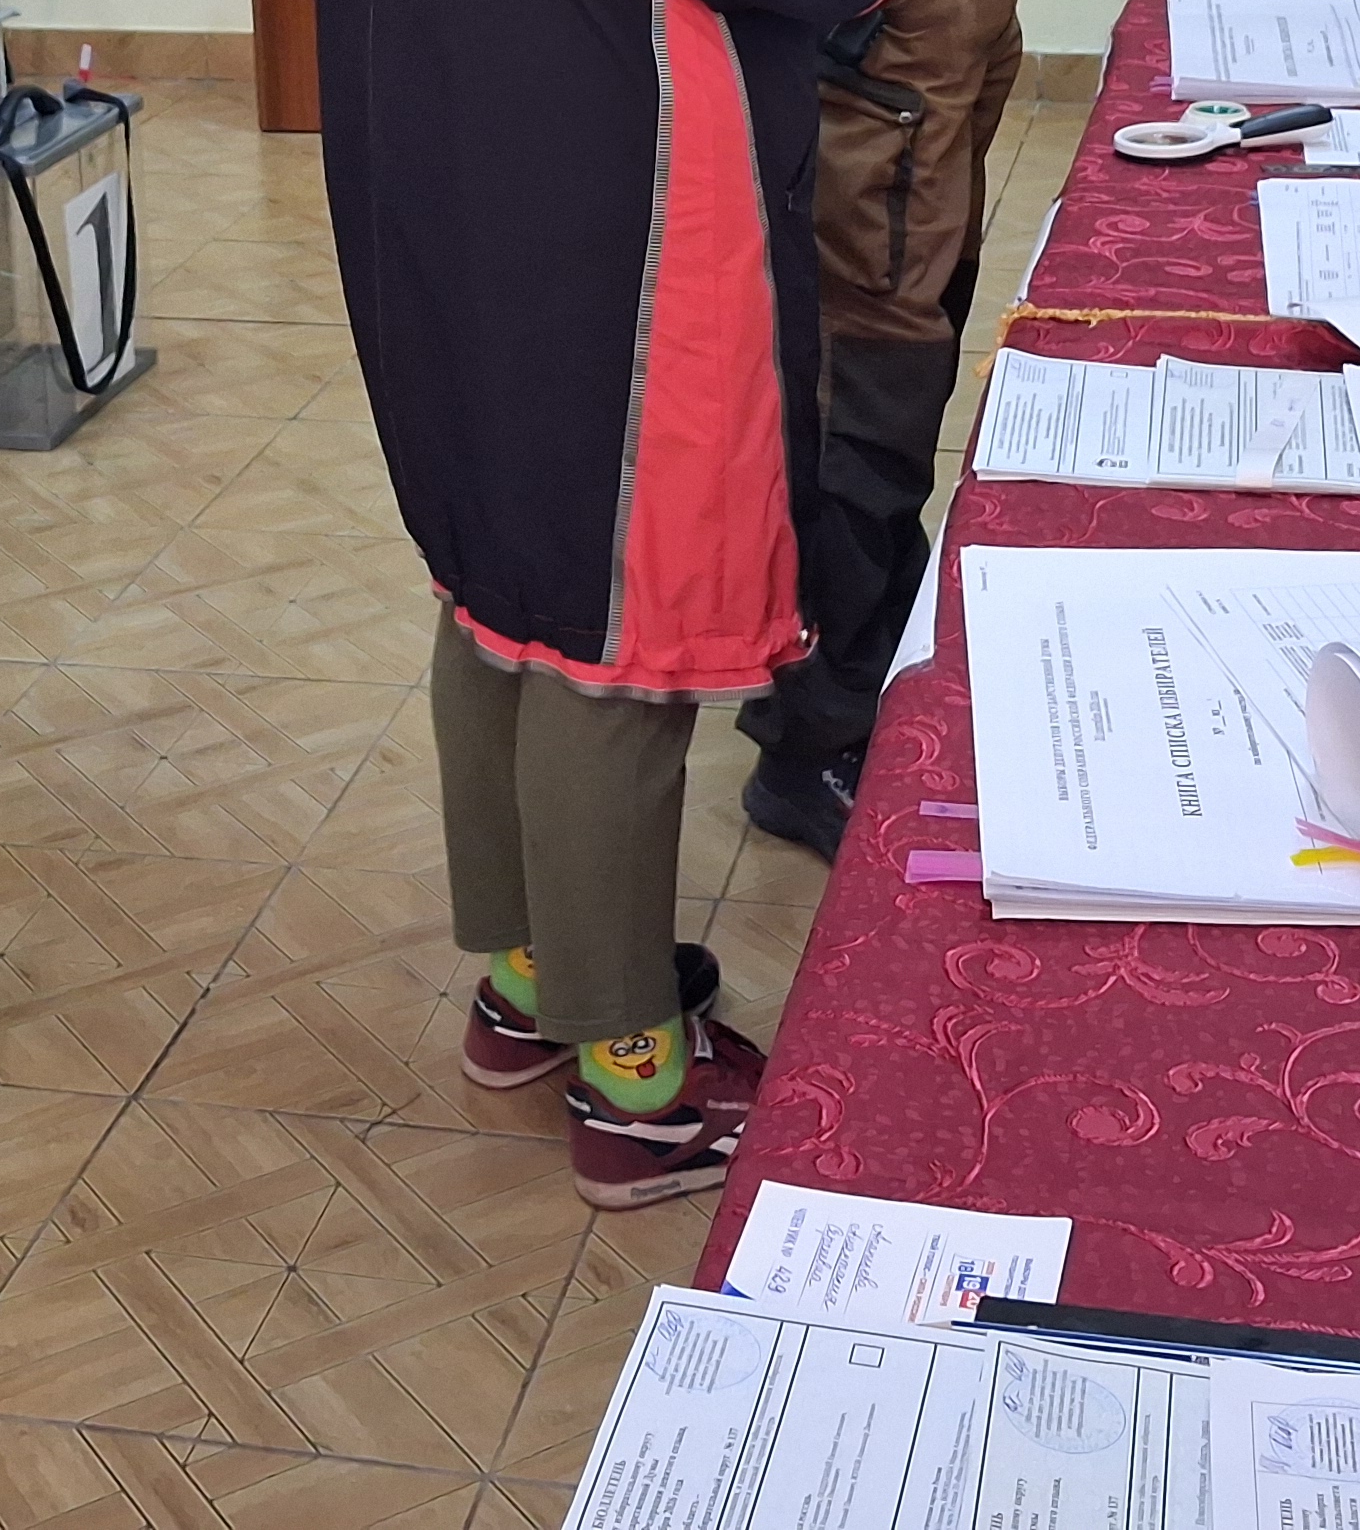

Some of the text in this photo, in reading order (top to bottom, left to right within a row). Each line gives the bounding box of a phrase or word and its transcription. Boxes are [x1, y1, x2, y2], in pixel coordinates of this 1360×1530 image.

[76, 191, 118, 370] 1
[1041, 658, 1059, 723] ГОСУДАРСТВЕННОЙ
[1062, 659, 1077, 699] ФЕДЕРАЦИИ
[1066, 701, 1084, 747] РОССИЙСКОЙ
[1141, 628, 1202, 817] КНИГА СПИСКА ИЗБИРАТЕЛЕЙ
[1050, 725, 1066, 767] ДЕПУТАТОВ
[1056, 769, 1069, 801] ВЫБОРЫ
[1074, 748, 1089, 788] СОБРАНИЯ
[1080, 789, 1098, 850] ФЕДЕРАЛЬНОГО
[768, 1266, 793, 1293] 429
[958, 1260, 976, 1273] 18
[962, 1276, 981, 1289] 19
[727, 1427, 738, 1440] 137
[591, 1460, 627, 1529] БЮЛЛЕТЕНЬ
